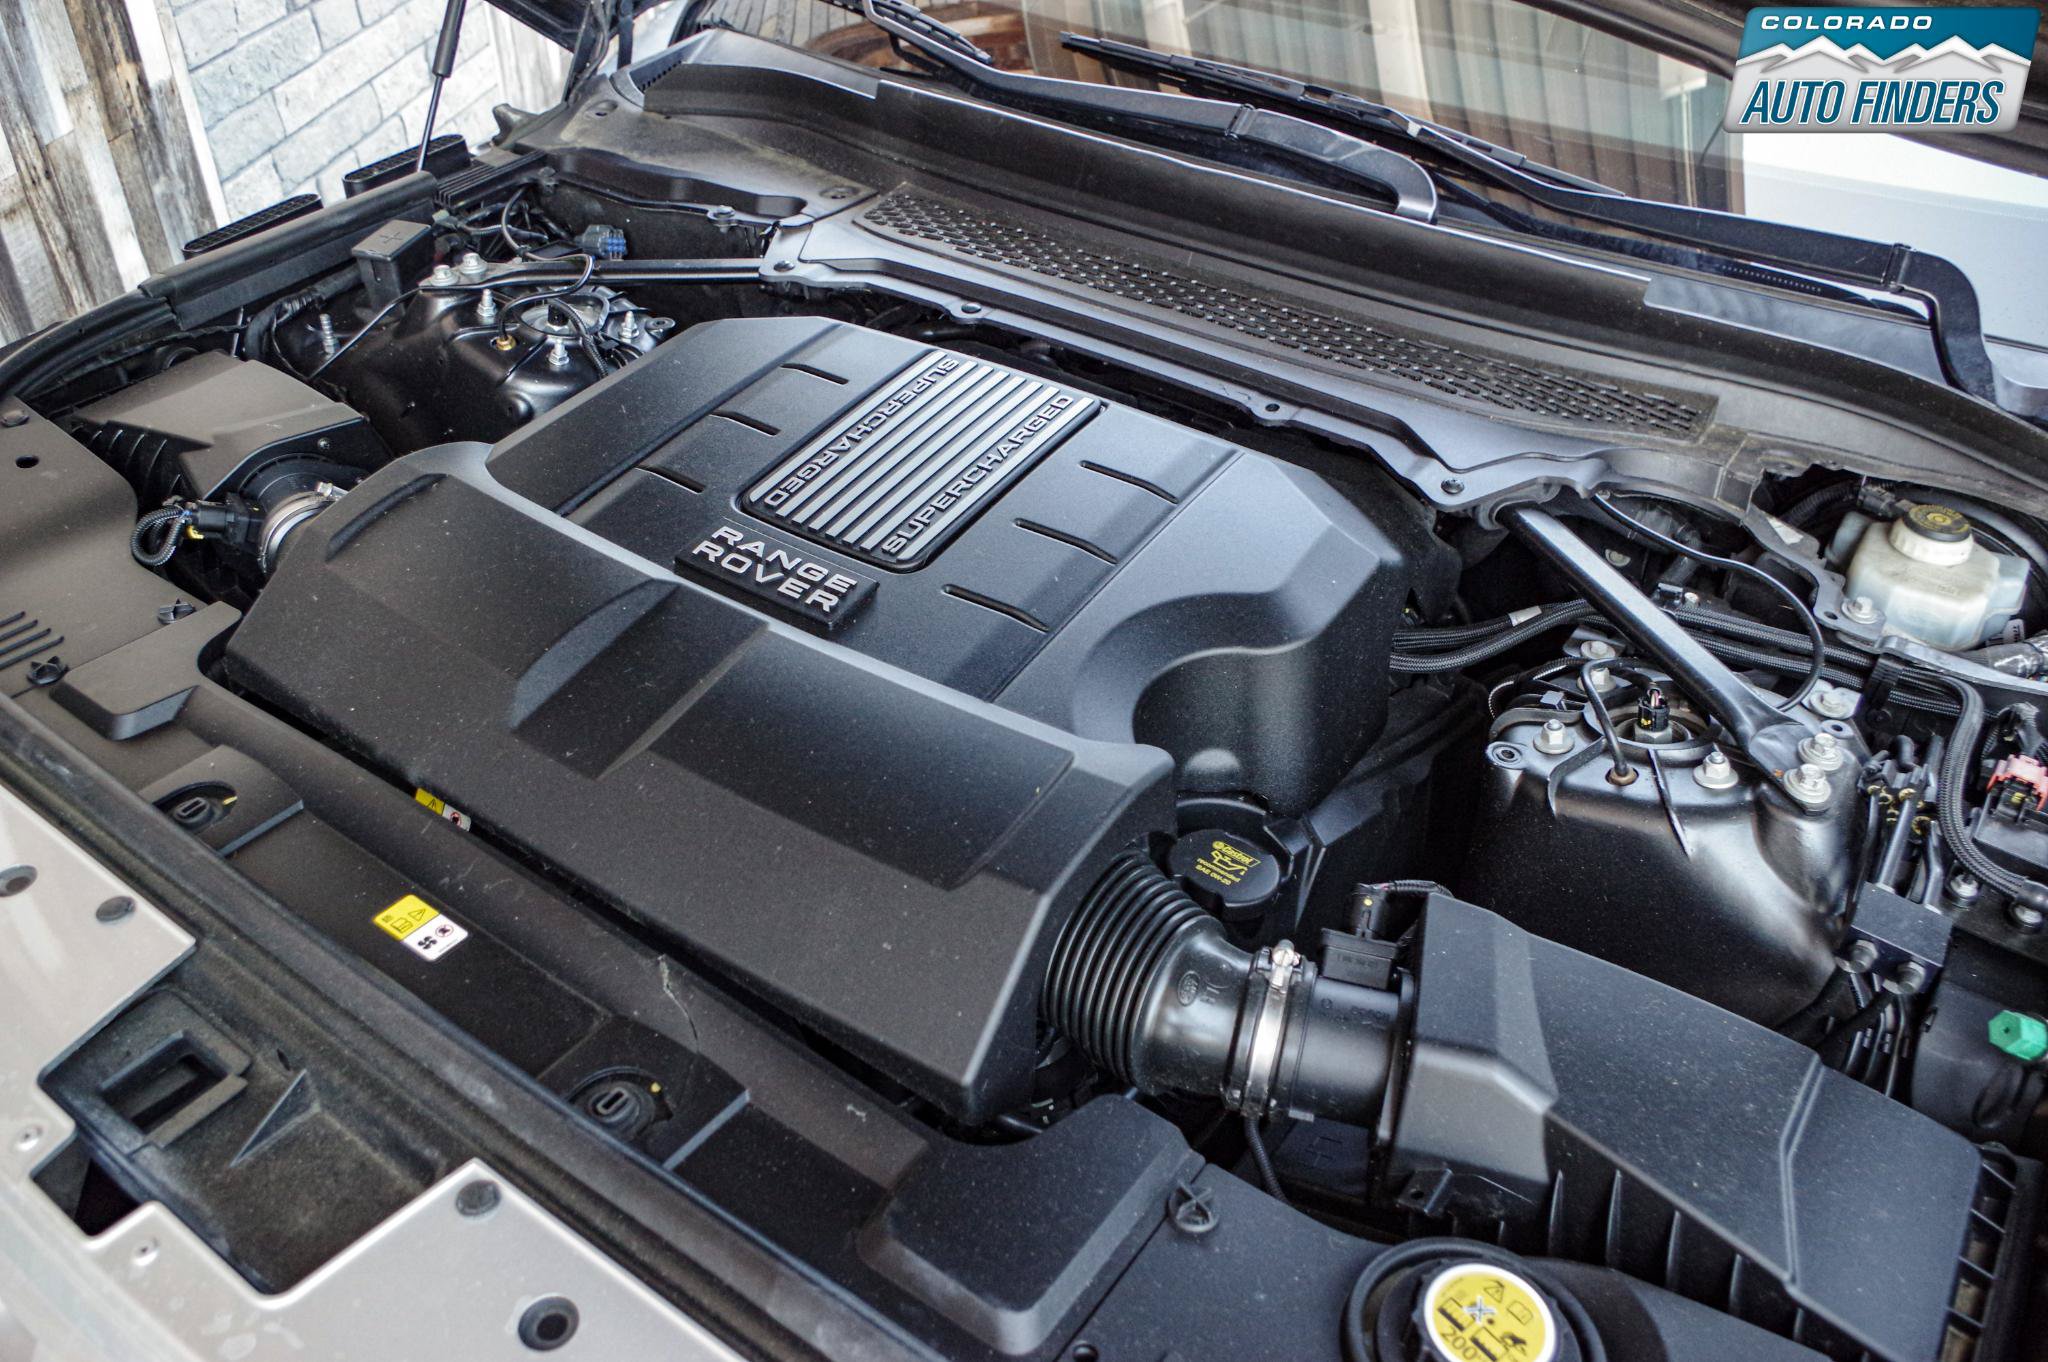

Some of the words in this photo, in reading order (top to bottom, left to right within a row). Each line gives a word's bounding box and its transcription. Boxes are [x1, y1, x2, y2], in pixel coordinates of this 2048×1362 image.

[763, 357, 960, 507] SUPERCHARGED
[881, 394, 1074, 555] SUPERCHARGED
[692, 540, 841, 613] ROVER
[710, 525, 858, 594] RANGE
[1195, 864, 1211, 875] SAE
[1222, 846, 1253, 865] Castrol
